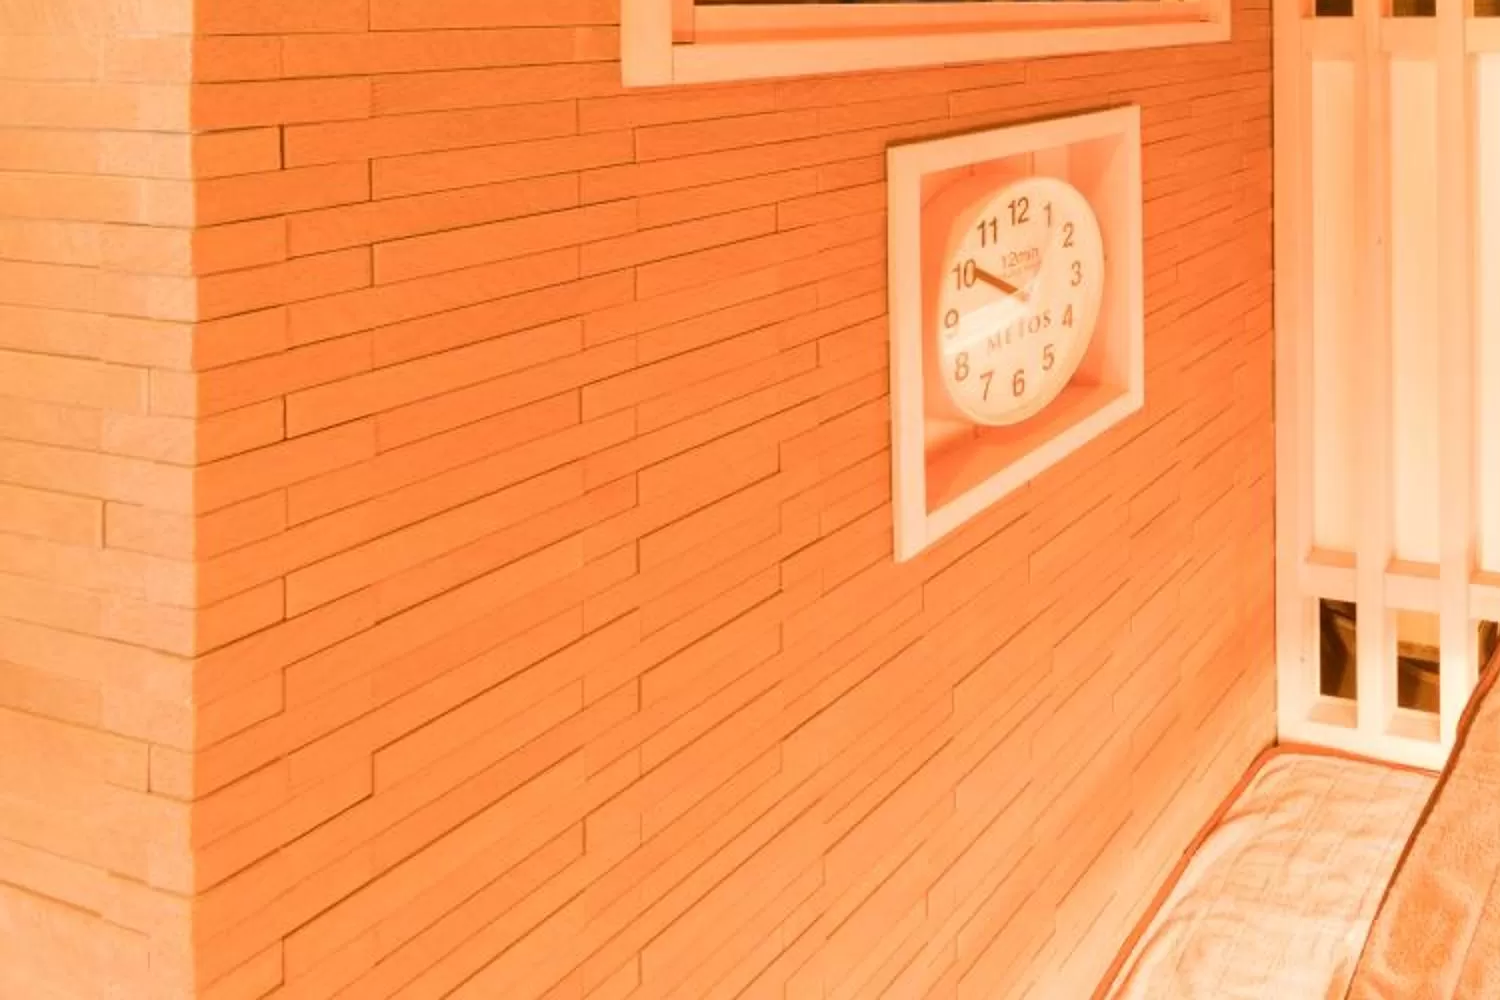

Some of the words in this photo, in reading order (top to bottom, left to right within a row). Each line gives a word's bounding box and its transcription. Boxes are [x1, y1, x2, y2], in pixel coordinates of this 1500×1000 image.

[1007, 195, 1030, 227] 12
[1043, 201, 1054, 229] 1
[976, 216, 1000, 249] 11
[1062, 221, 1075, 249] 2
[951, 258, 978, 291] 10
[1070, 260, 1083, 287] 3
[944, 308, 959, 338] 9
[988, 310, 1052, 351] METOS
[1061, 303, 1073, 328] 4
[954, 351, 970, 382] 8
[1042, 342, 1055, 372] 5
[979, 370, 994, 402] 7
[1012, 368, 1025, 398] 6
